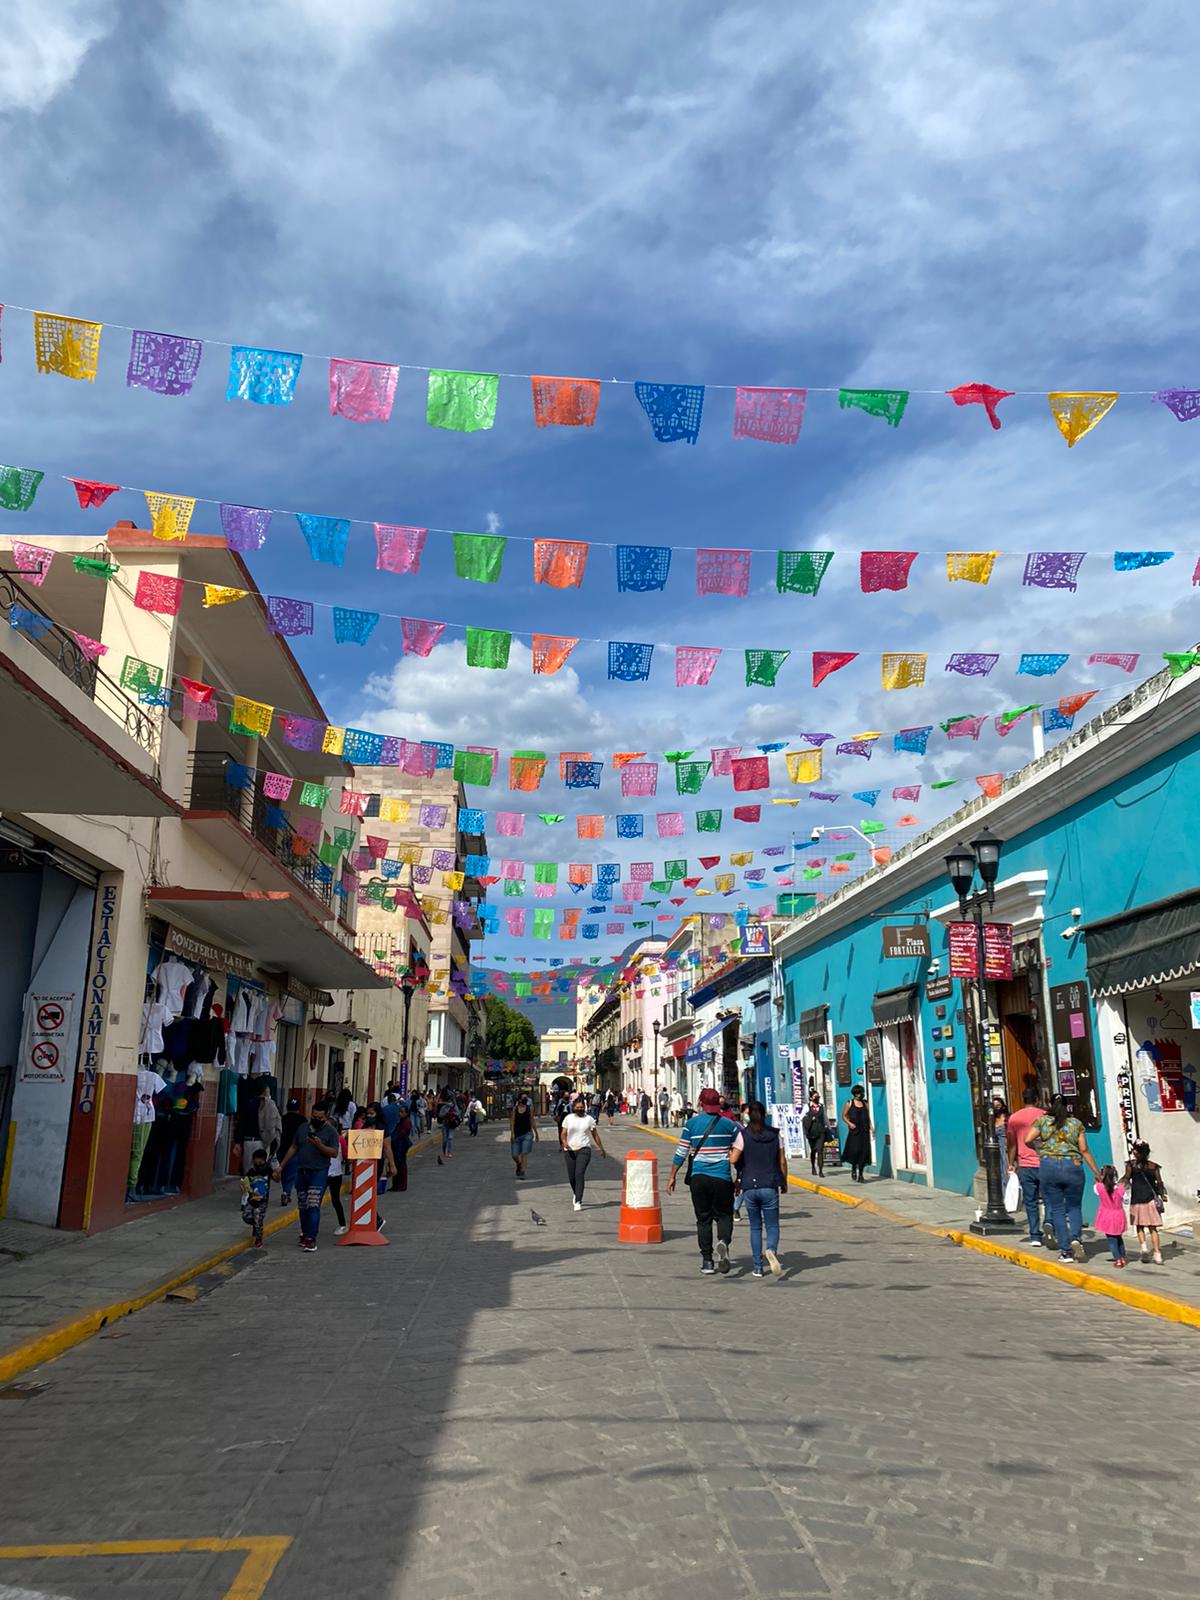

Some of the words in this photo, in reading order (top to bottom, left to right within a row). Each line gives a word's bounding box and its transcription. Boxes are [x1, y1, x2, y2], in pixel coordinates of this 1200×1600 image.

[889, 945, 926, 956] FORTALEZA
[79, 886, 117, 1115] ESTACIONAMIENTO
[776, 1104, 789, 1112] WC
[786, 1116, 800, 1124] WC
